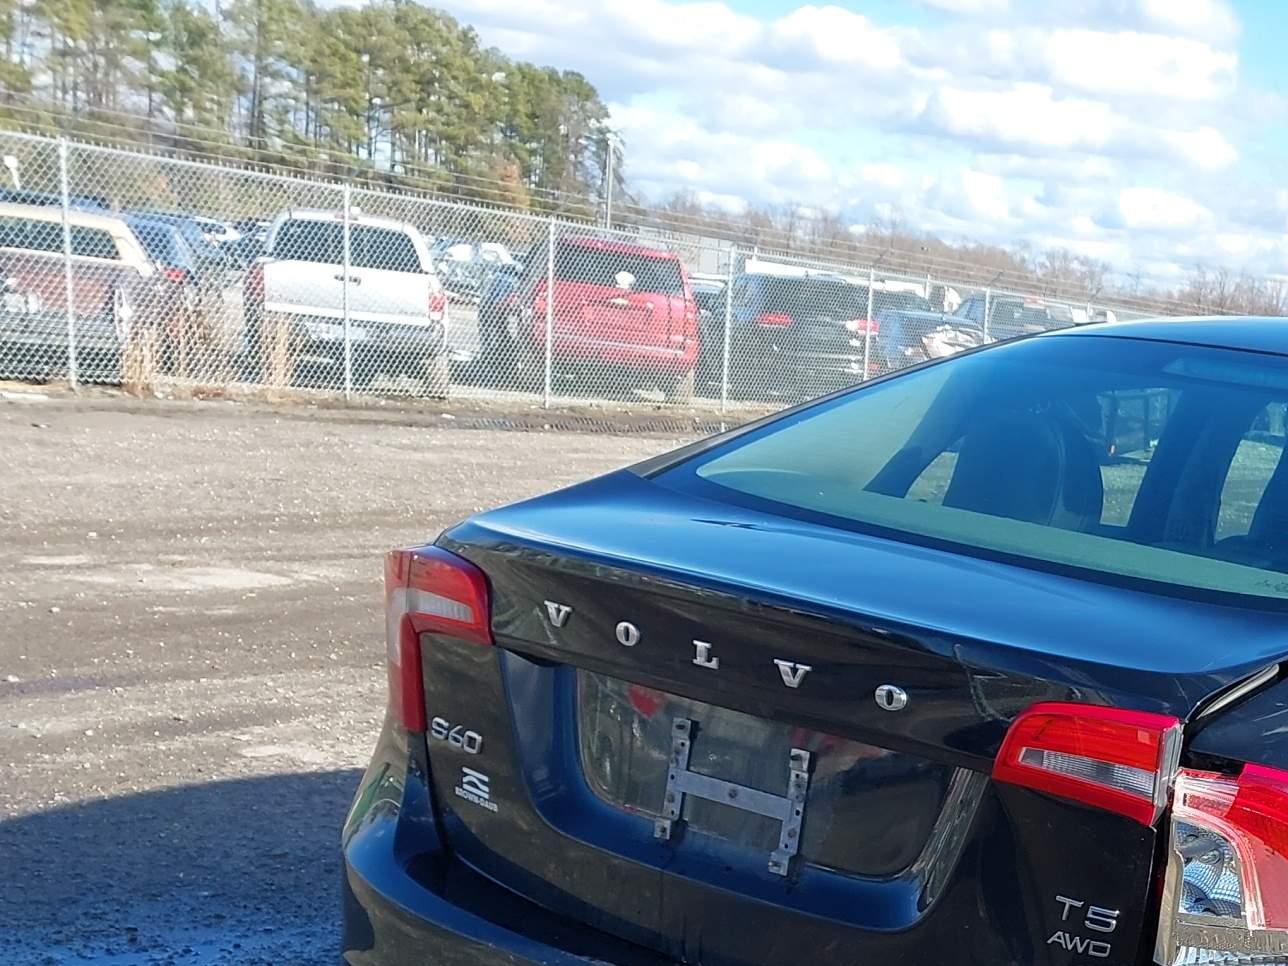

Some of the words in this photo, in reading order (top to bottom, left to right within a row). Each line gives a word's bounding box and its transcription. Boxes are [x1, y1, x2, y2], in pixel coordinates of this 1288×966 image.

[544, 600, 908, 711] VOLVO
[431, 716, 482, 754] S60
[1055, 895, 1120, 932] T5
[1046, 931, 1111, 957] AWD
